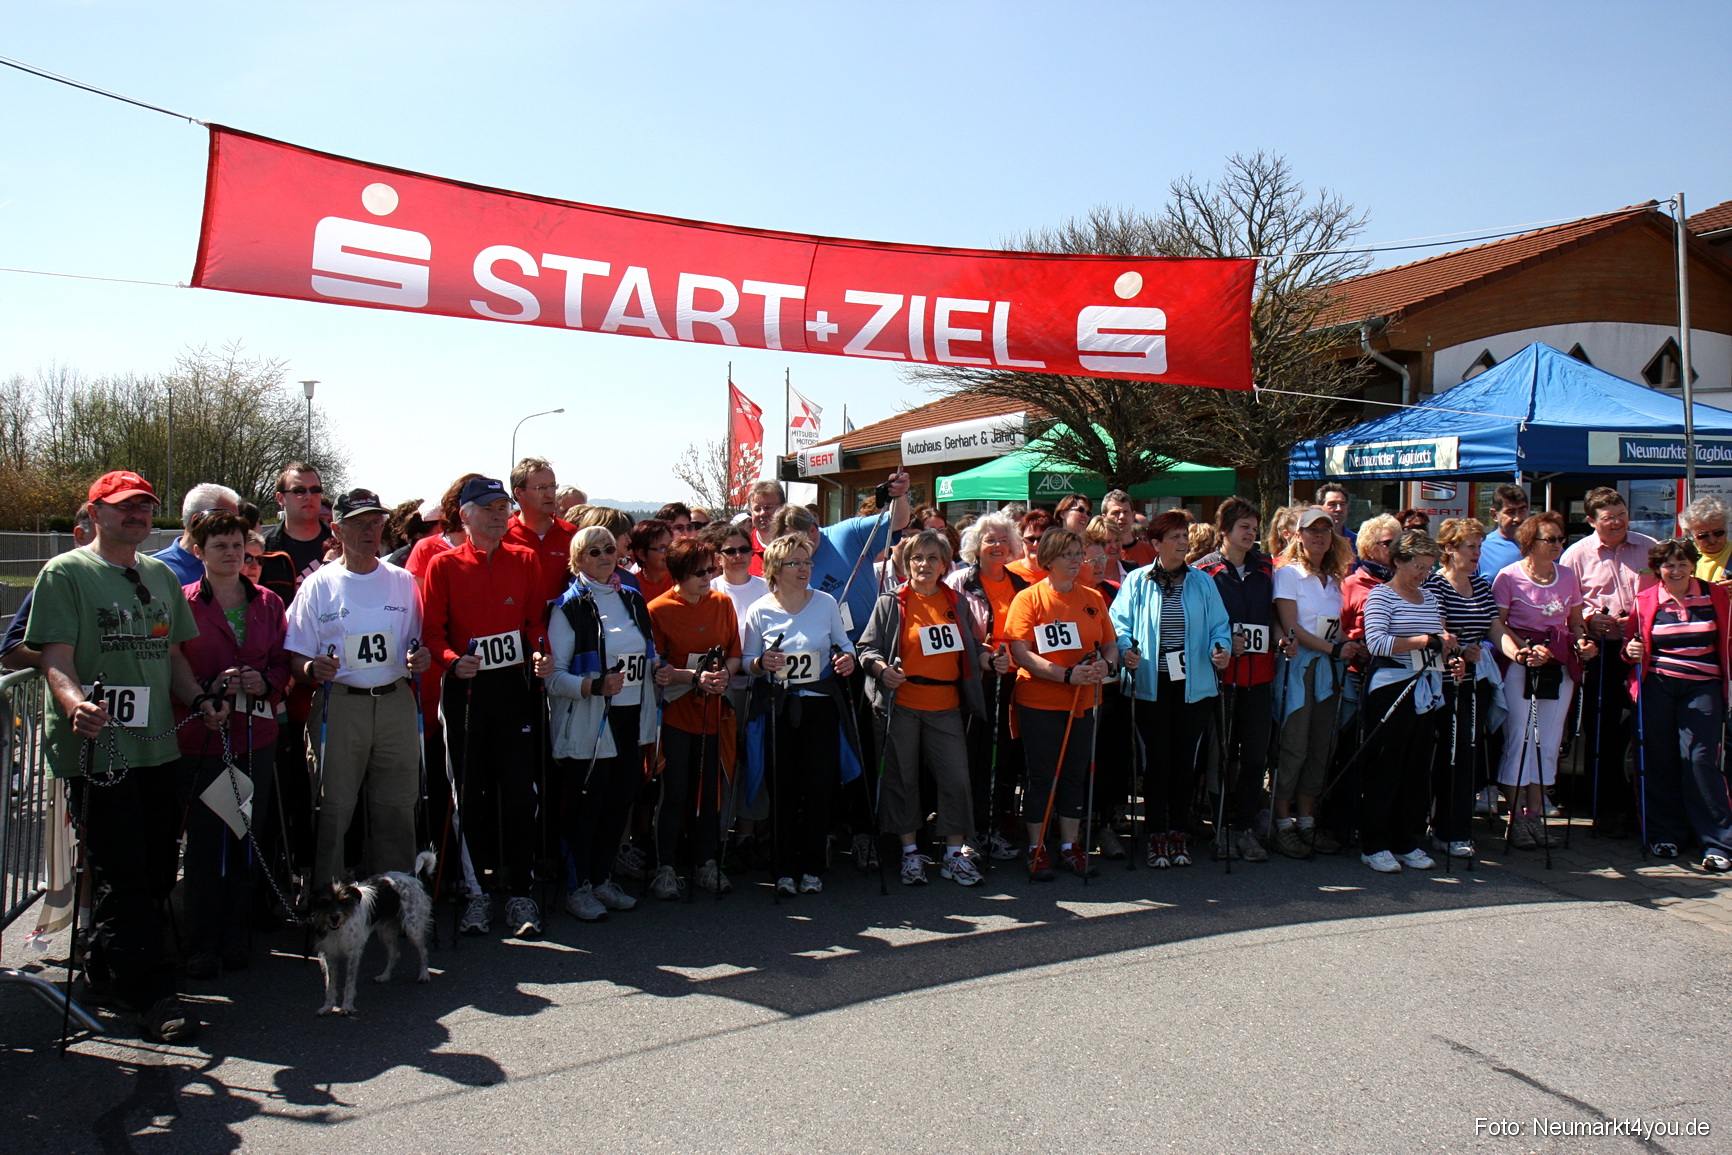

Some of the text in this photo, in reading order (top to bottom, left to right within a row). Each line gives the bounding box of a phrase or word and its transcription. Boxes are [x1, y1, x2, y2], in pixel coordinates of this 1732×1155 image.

[907, 440, 942, 455] Autohaus
[944, 433, 978, 450] Gerhart
[980, 431, 988, 445] &
[1625, 442, 1687, 460] Neumarkte
[809, 453, 834, 467] SEAT
[1348, 449, 1432, 468] Neumarkter Tagblatt
[938, 479, 954, 494] AOK
[1037, 473, 1075, 491] AOK
[928, 625, 954, 650] 96
[1044, 623, 1072, 647] 95
[1324, 618, 1340, 640] 72
[357, 633, 388, 664] 43
[479, 634, 517, 666] 103
[626, 654, 645, 682] 50
[786, 654, 812, 680] 22
